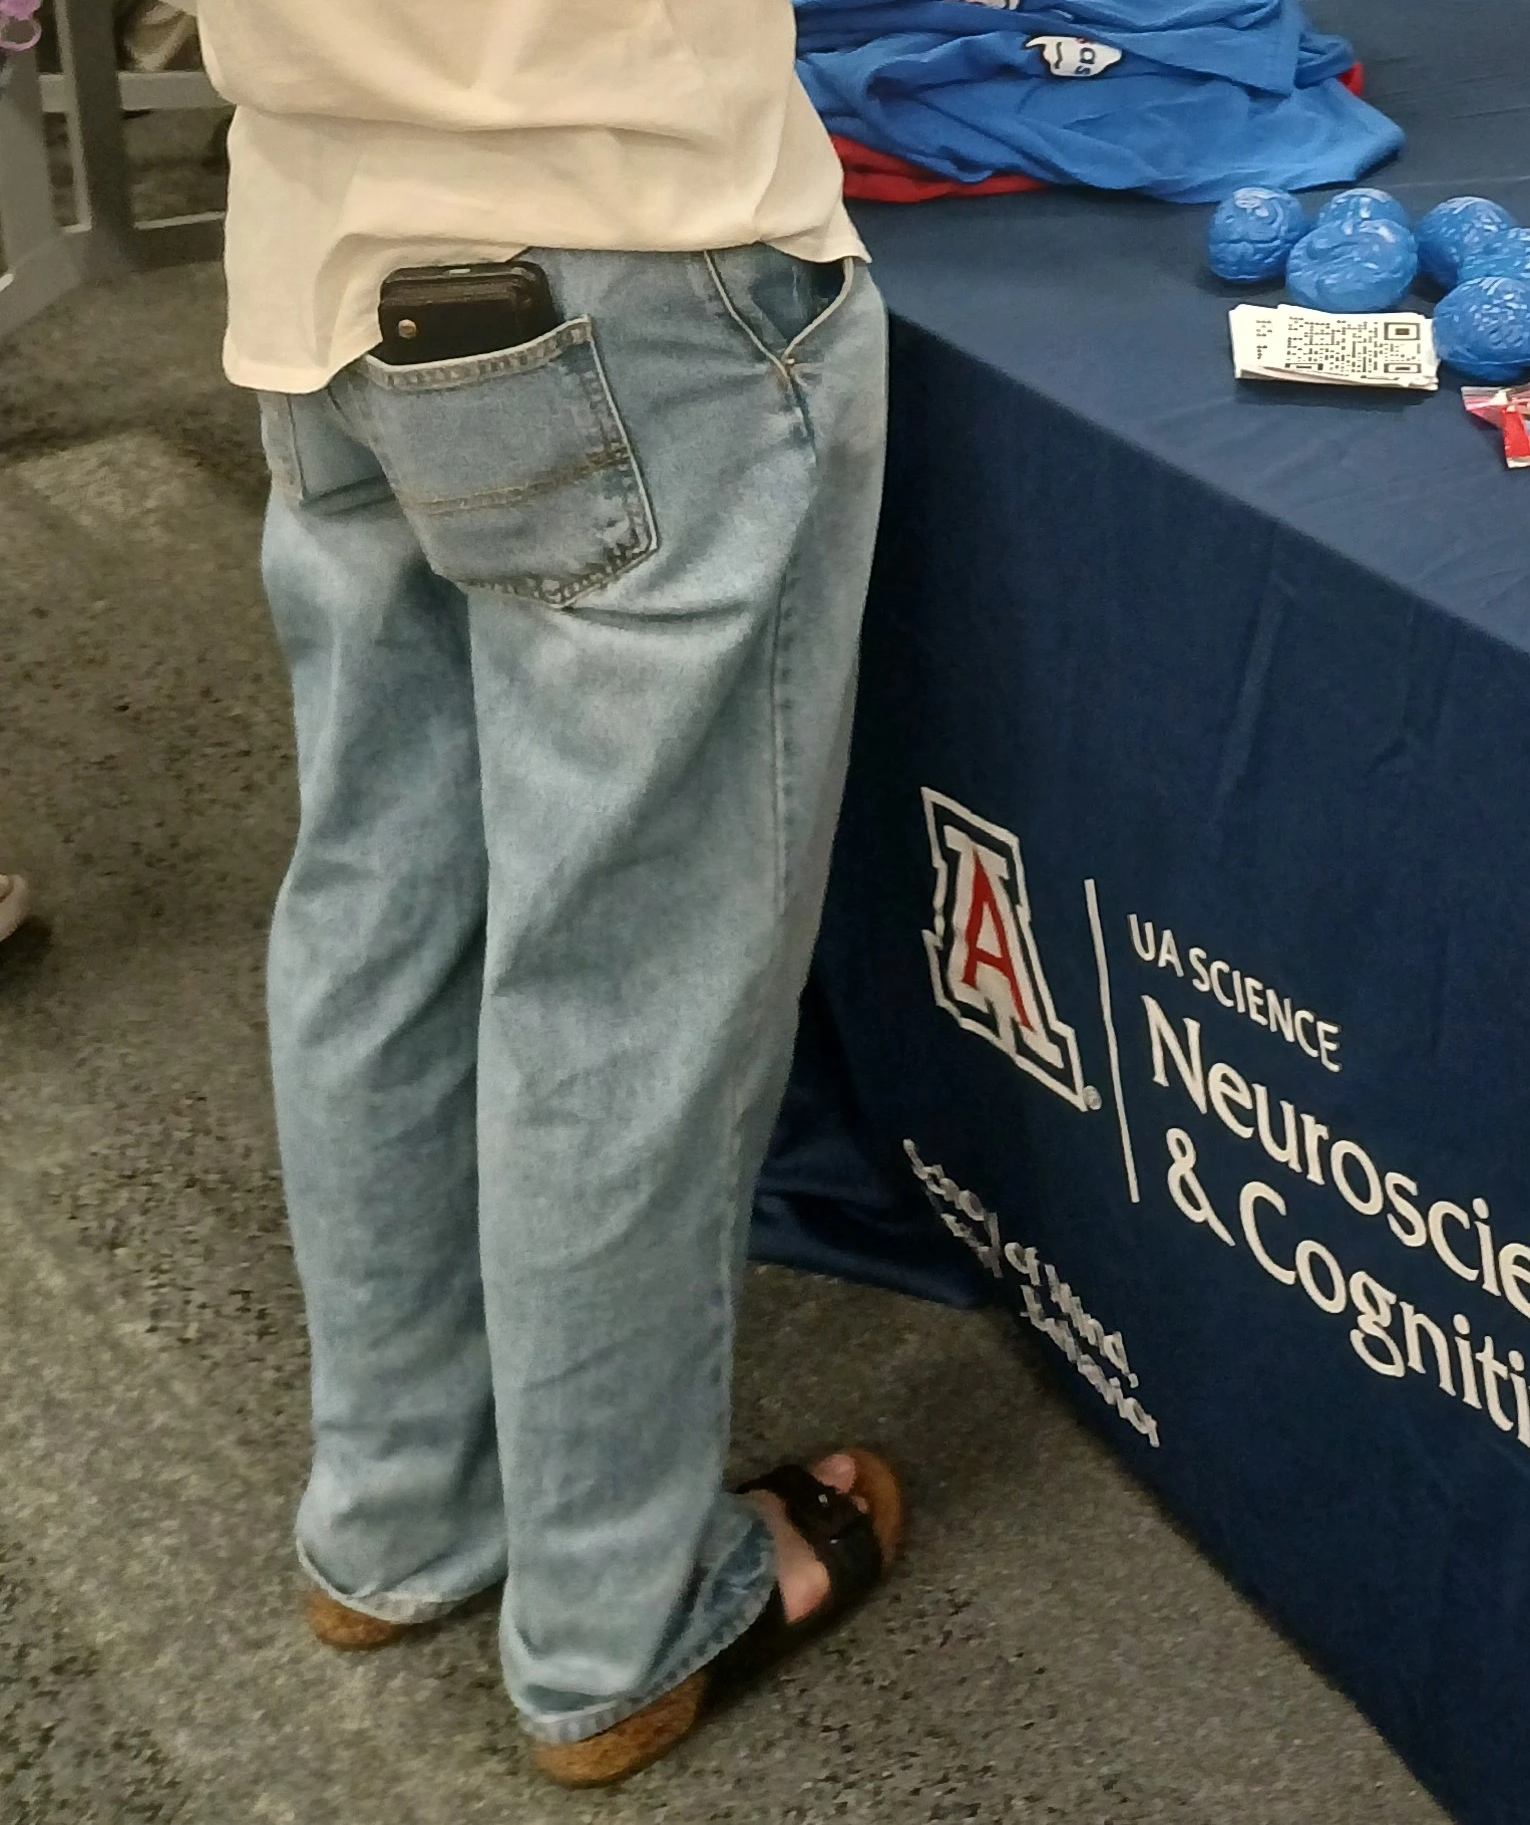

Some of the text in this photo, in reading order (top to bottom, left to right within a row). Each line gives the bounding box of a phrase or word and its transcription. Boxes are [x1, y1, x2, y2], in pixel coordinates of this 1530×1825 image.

[922, 786, 1086, 1112] A
[1127, 912, 1343, 1073] UA SCIENCE
[1166, 1127, 1236, 1247] &
